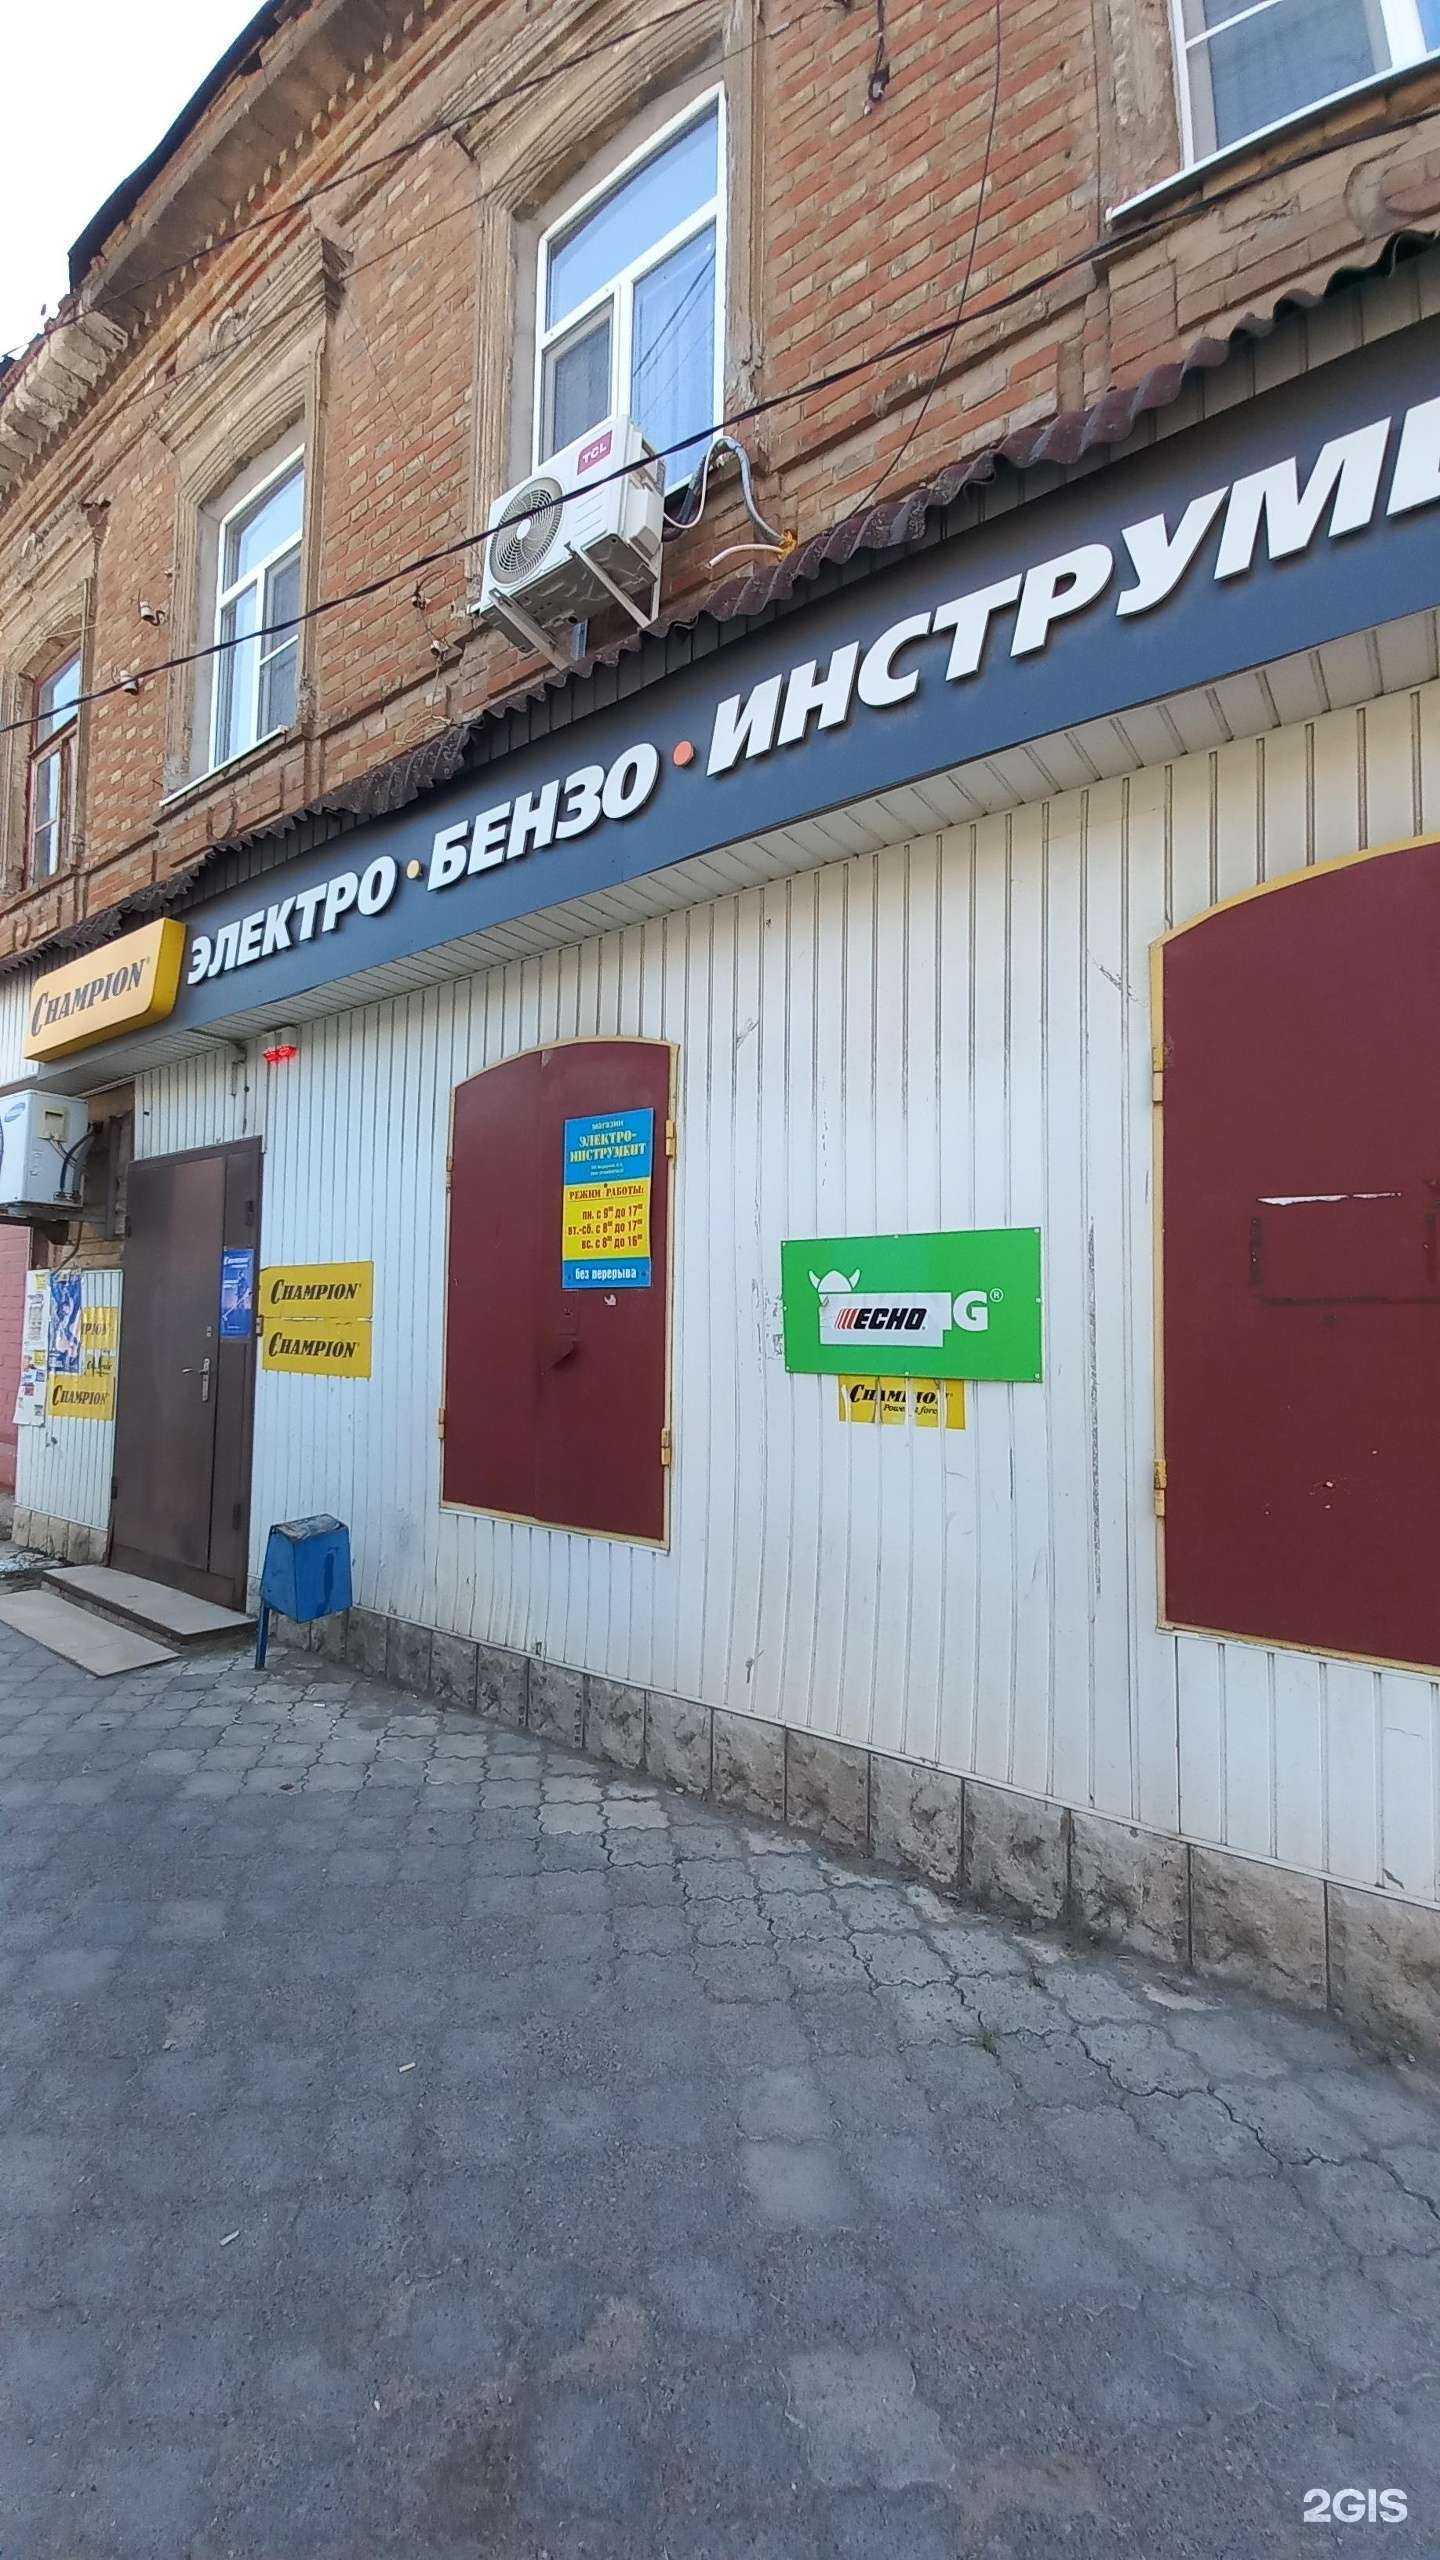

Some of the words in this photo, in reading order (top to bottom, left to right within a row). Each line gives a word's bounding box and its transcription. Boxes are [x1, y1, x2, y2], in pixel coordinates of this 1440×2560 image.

[582, 441, 607, 463] TCL
[187, 855, 398, 985] ЭЛЕКТРО
[427, 743, 660, 891] БЕНЗО
[569, 1188, 603, 1199] РЕЖИМ
[615, 1208, 626, 1219] до
[614, 1222, 625, 1234] до
[614, 1238, 625, 1249] до
[575, 1268, 589, 1280] без
[592, 1268, 637, 1281] перерыва
[854, 1308, 927, 1330] ECHO
